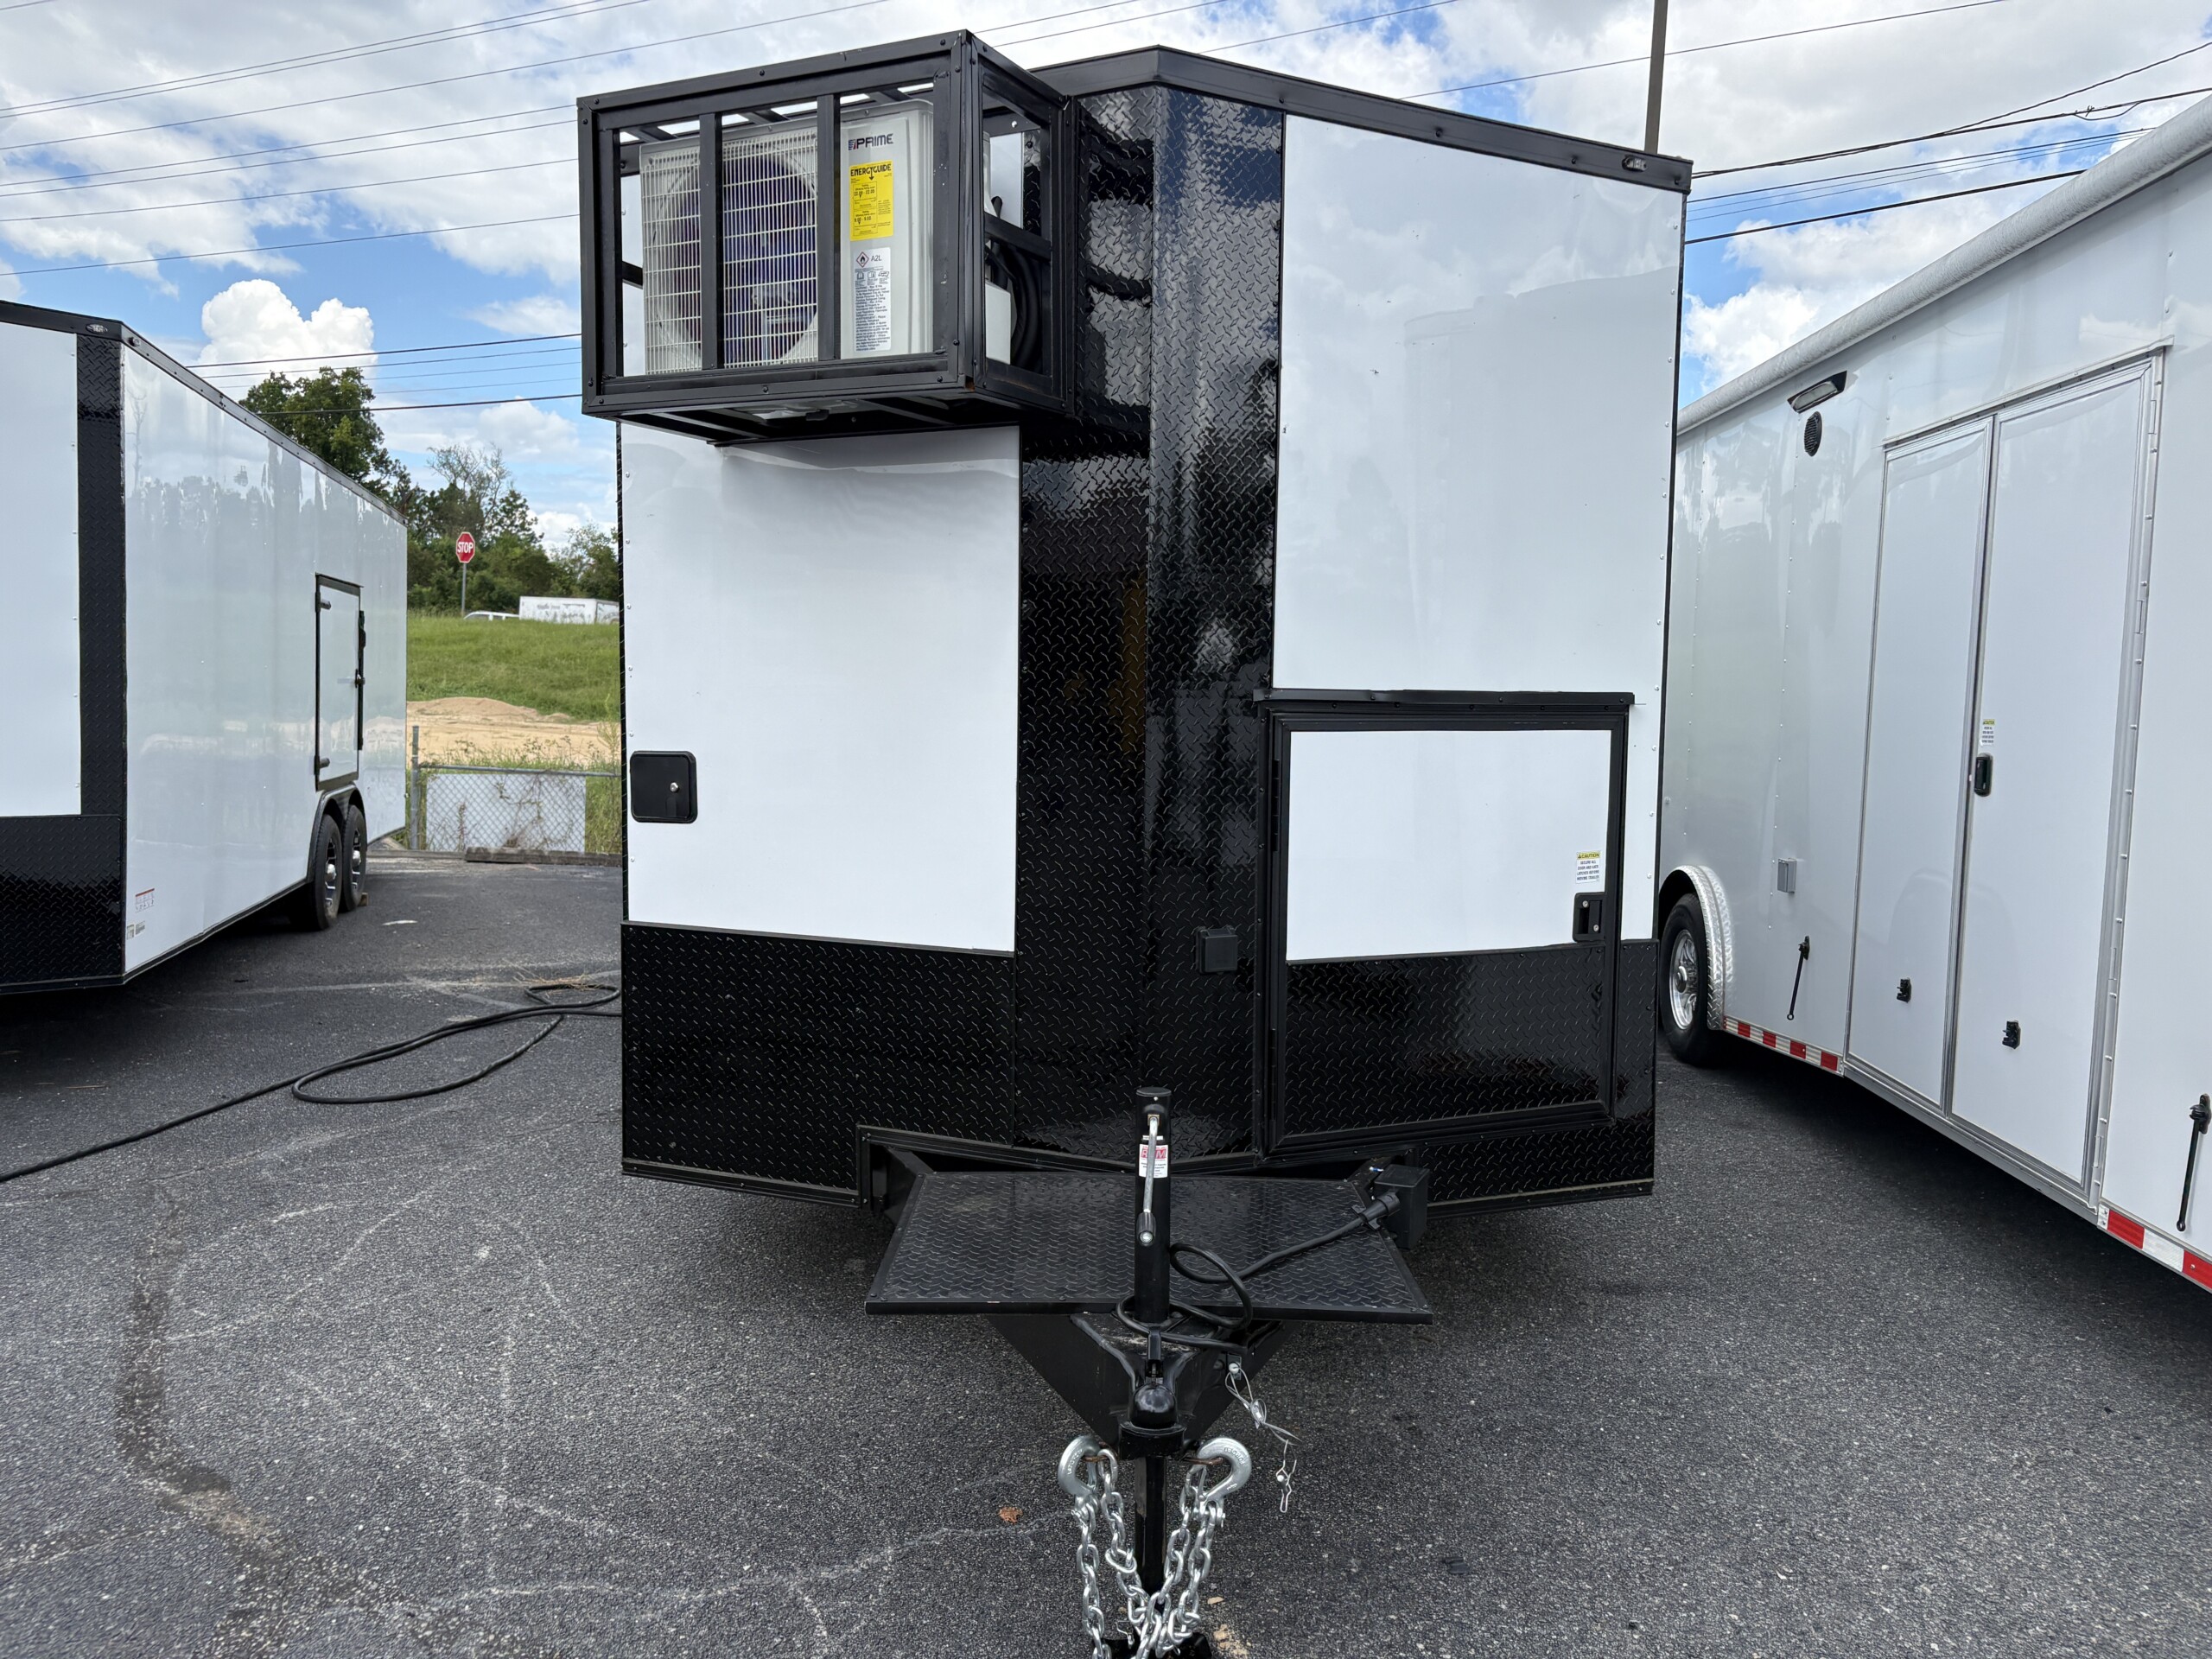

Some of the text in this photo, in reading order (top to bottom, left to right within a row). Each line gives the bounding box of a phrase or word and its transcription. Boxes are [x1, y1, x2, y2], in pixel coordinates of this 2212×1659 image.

[856, 133, 893, 149] PRIME
[850, 163, 892, 177] ENERGYGUIDE
[457, 541, 474, 554] STOP
